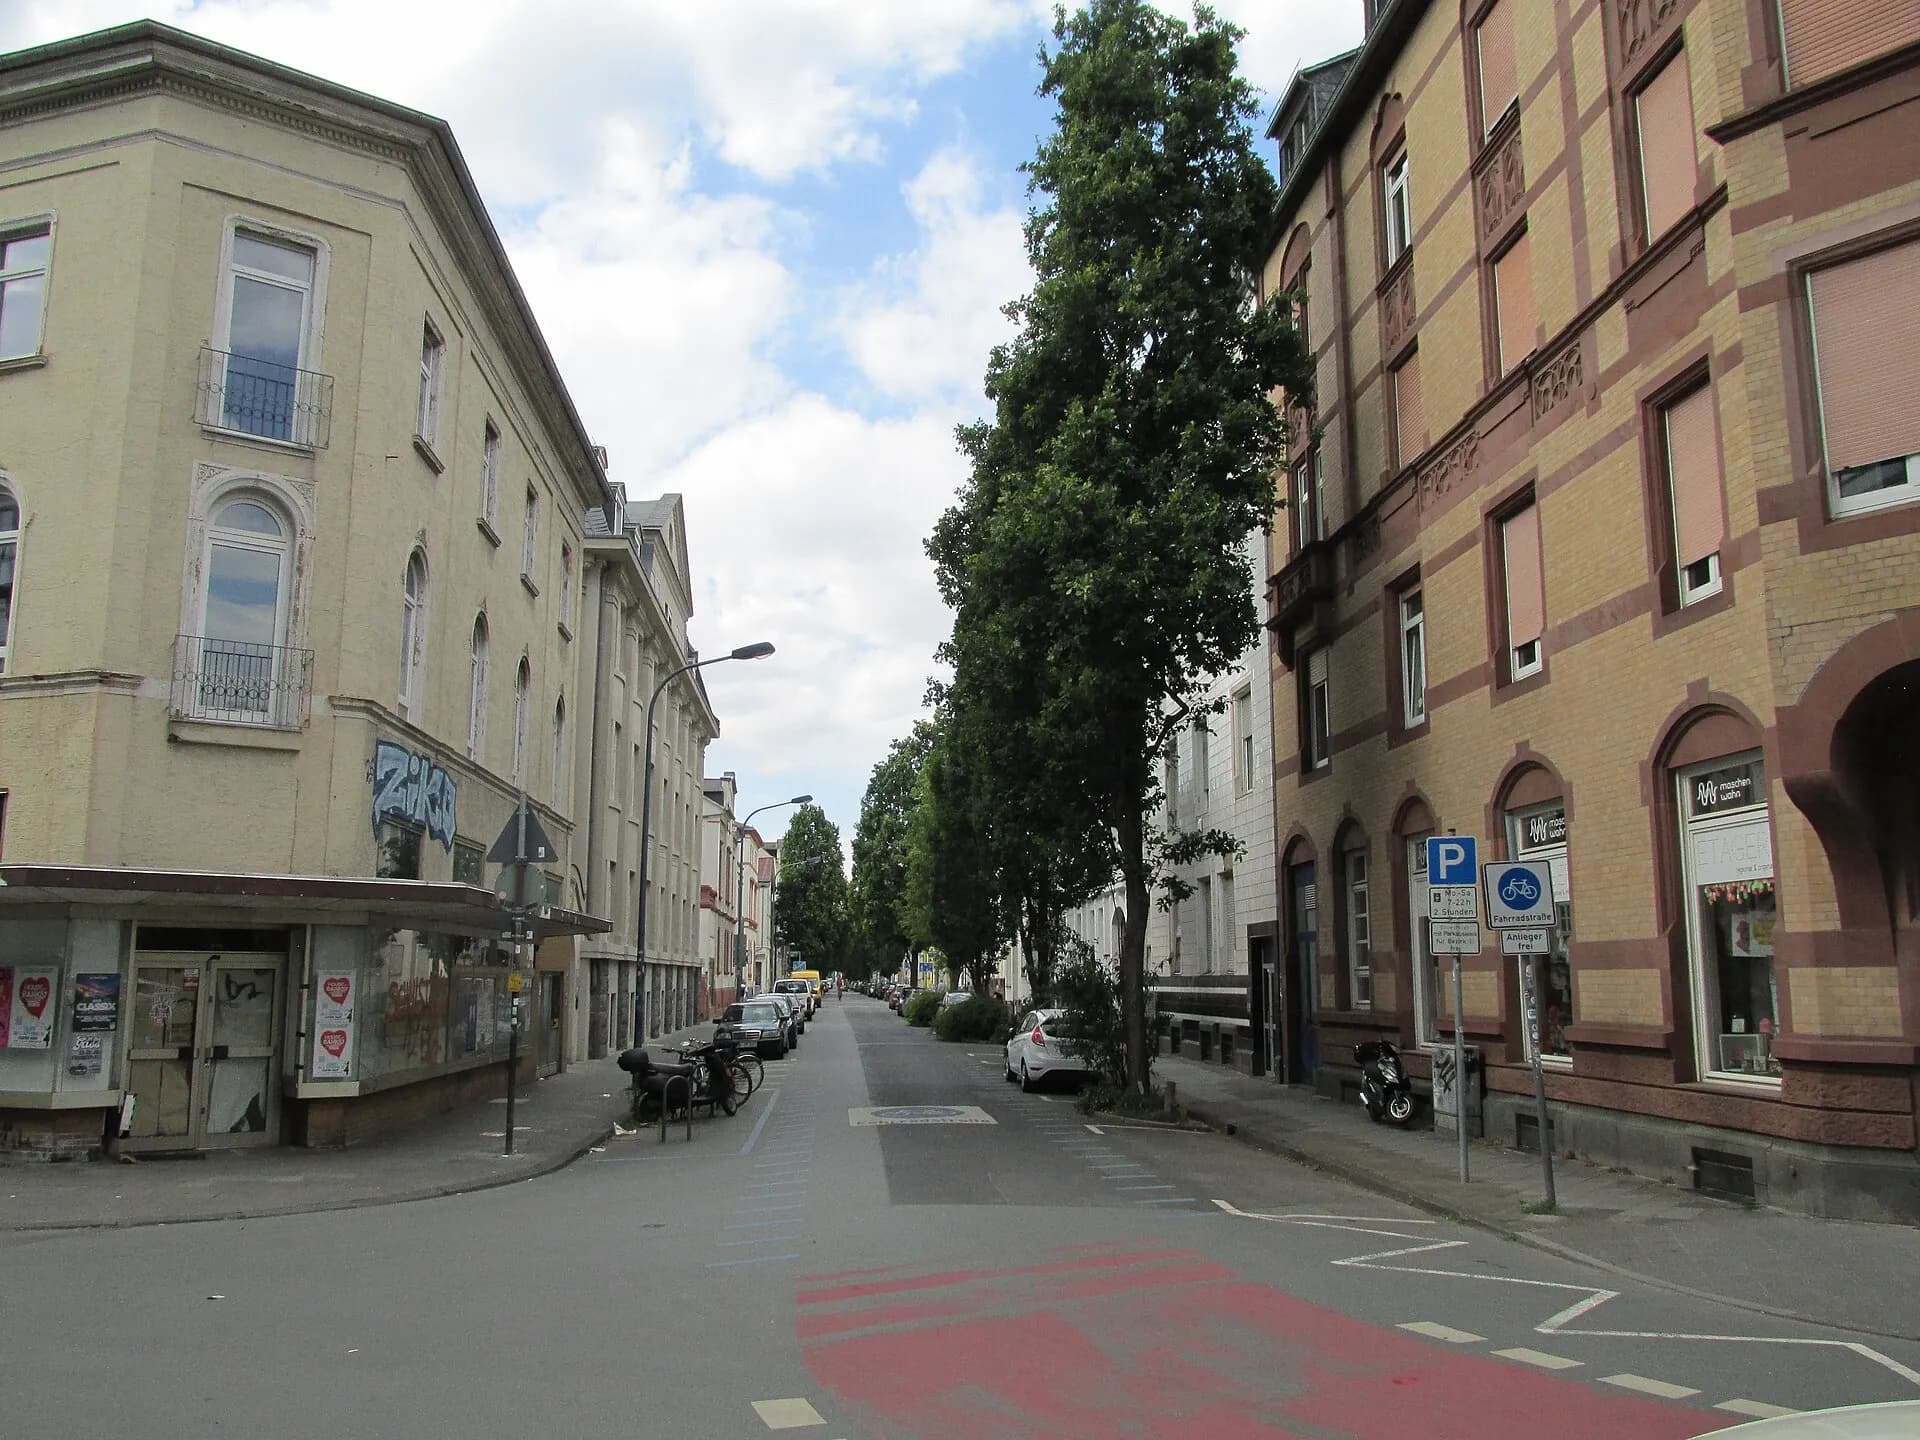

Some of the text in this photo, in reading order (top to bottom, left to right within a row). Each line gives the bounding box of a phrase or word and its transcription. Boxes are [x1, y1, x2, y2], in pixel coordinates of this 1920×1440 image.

[1719, 777, 1751, 790] maschen
[1720, 789, 1741, 801] wahn
[1439, 843, 1465, 879] P
[1444, 889, 1471, 897] Mo-Sa
[1433, 908, 1474, 916] 2 Stunden
[1493, 913, 1552, 923] Fahrradstraße
[1506, 933, 1543, 942] Anlieger
[1518, 942, 1533, 950] frei
